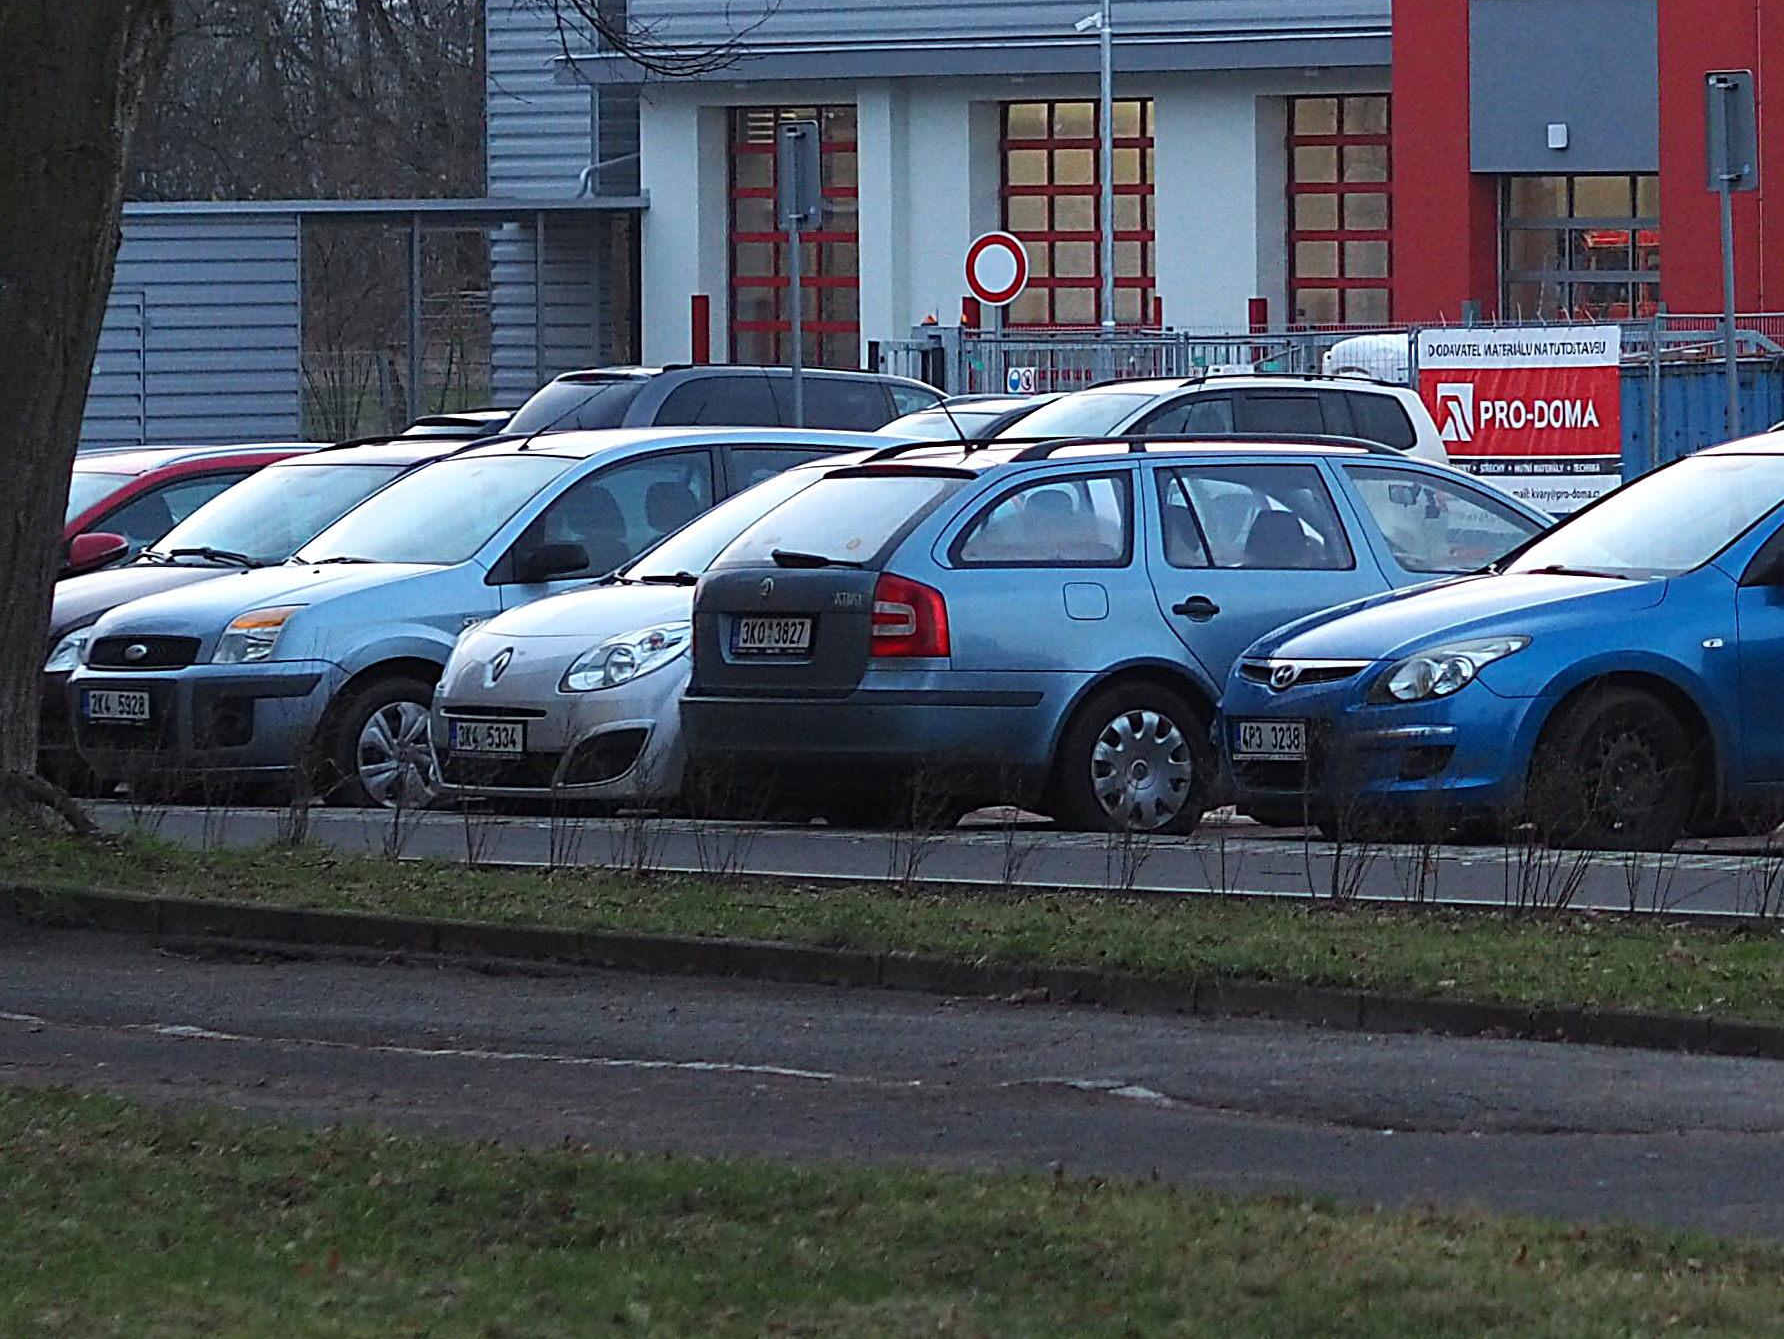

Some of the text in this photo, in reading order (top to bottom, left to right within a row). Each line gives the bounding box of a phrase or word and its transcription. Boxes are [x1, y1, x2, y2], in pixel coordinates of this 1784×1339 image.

[1428, 344, 1481, 357] DODAVATEL
[1479, 399, 1600, 430] PRO-DOMA
[775, 620, 804, 645] 3827
[118, 694, 145, 715] 5928
[487, 725, 516, 749] 5334
[1243, 725, 1300, 750] 4P3 3238
